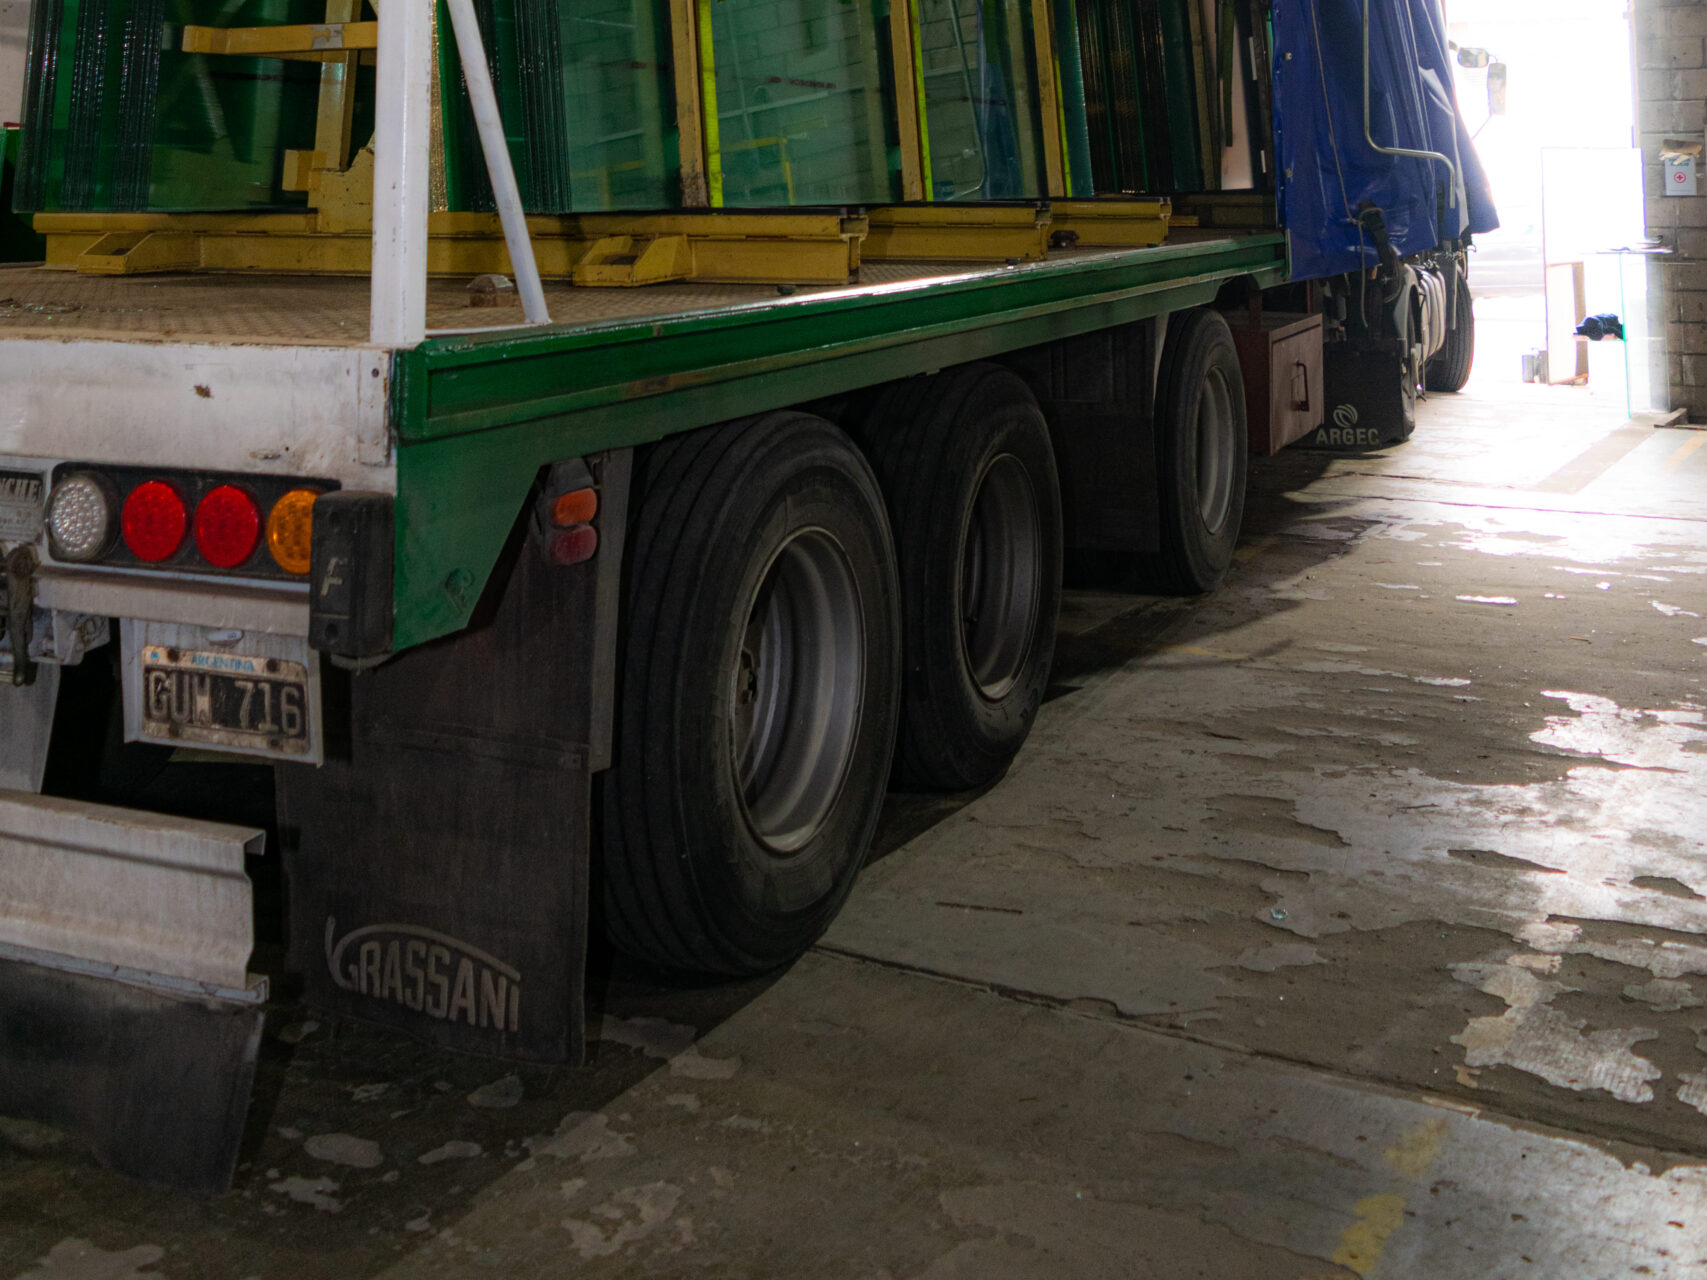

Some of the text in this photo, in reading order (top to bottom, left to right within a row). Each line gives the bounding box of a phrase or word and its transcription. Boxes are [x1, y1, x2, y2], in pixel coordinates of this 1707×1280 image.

[1315, 427, 1381, 446] ARGEC
[191, 655, 255, 673] ARGENTINA
[234, 680, 303, 737] 716
[323, 914, 522, 1033] GRASSANI
